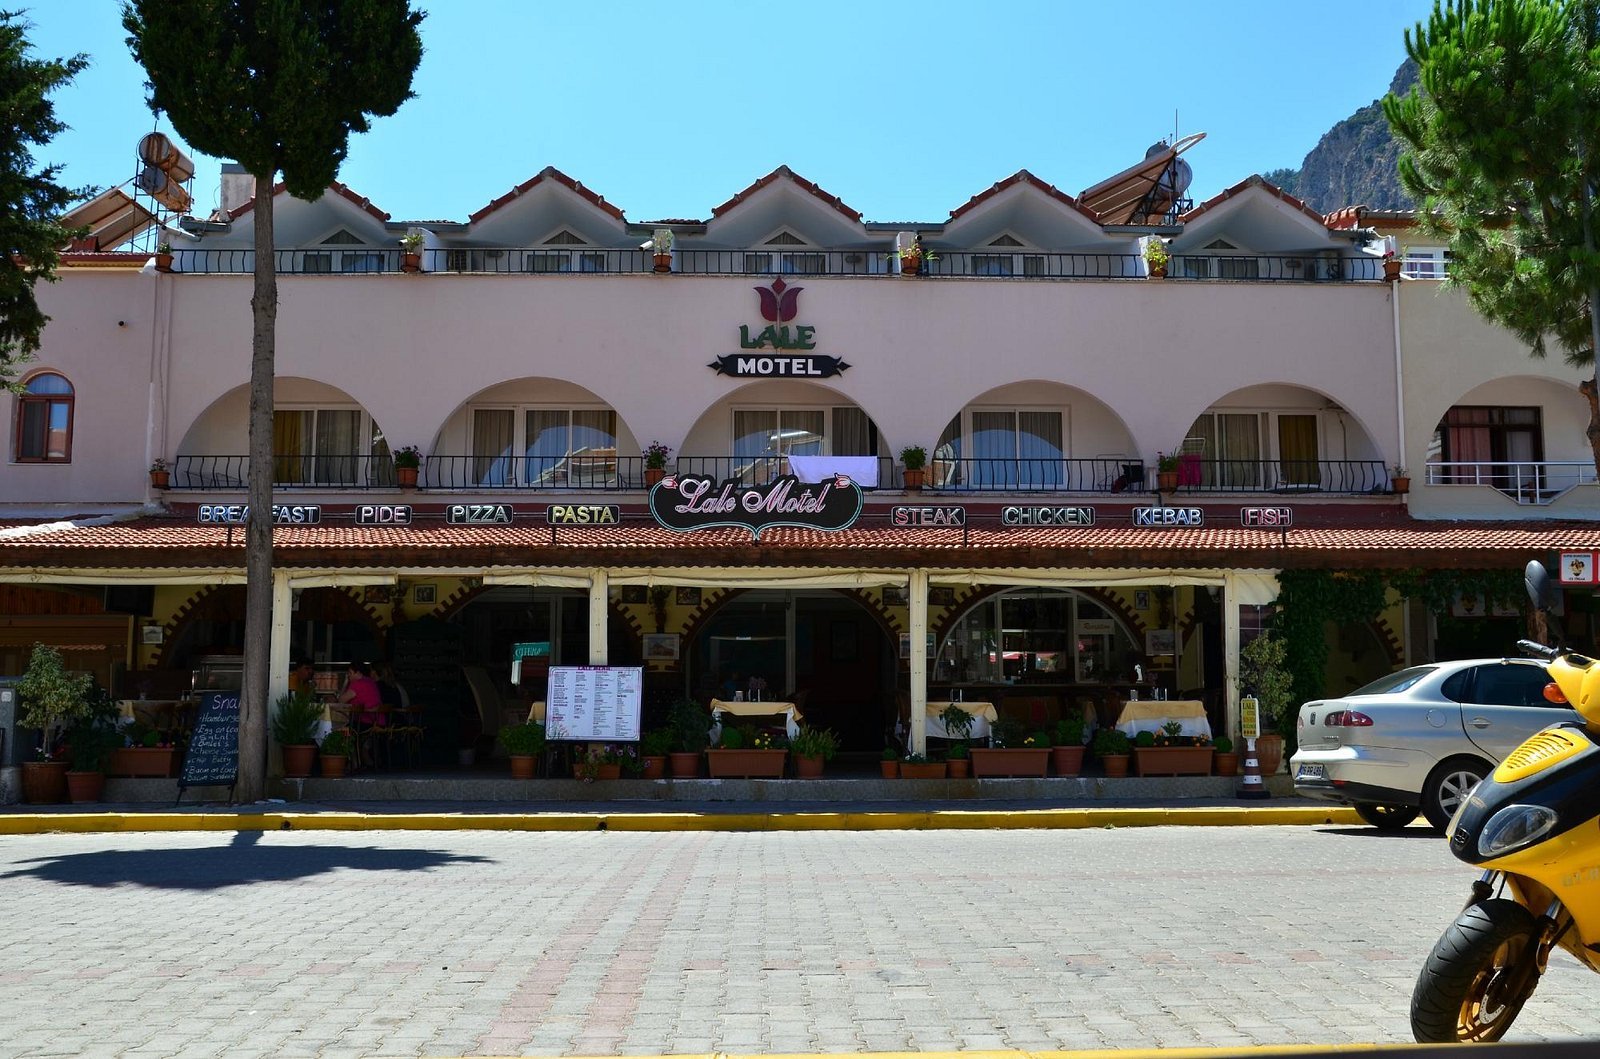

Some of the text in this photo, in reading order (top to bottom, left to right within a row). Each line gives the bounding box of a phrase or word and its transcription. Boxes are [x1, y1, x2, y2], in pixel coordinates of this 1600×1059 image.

[739, 324, 817, 350] LALE
[737, 358, 822, 375] MOTEL
[674, 478, 832, 514] Lale Motel
[200, 505, 318, 523] BREAFAST
[361, 506, 408, 523] PIDE
[451, 505, 509, 523] PIZZA
[552, 505, 616, 523] PASTA
[895, 507, 962, 526] STEAK
[1004, 507, 1092, 525] CHICKEN
[1136, 508, 1202, 526] KEBAB
[1245, 508, 1290, 526] FISH
[212, 694, 241, 710] Sna
